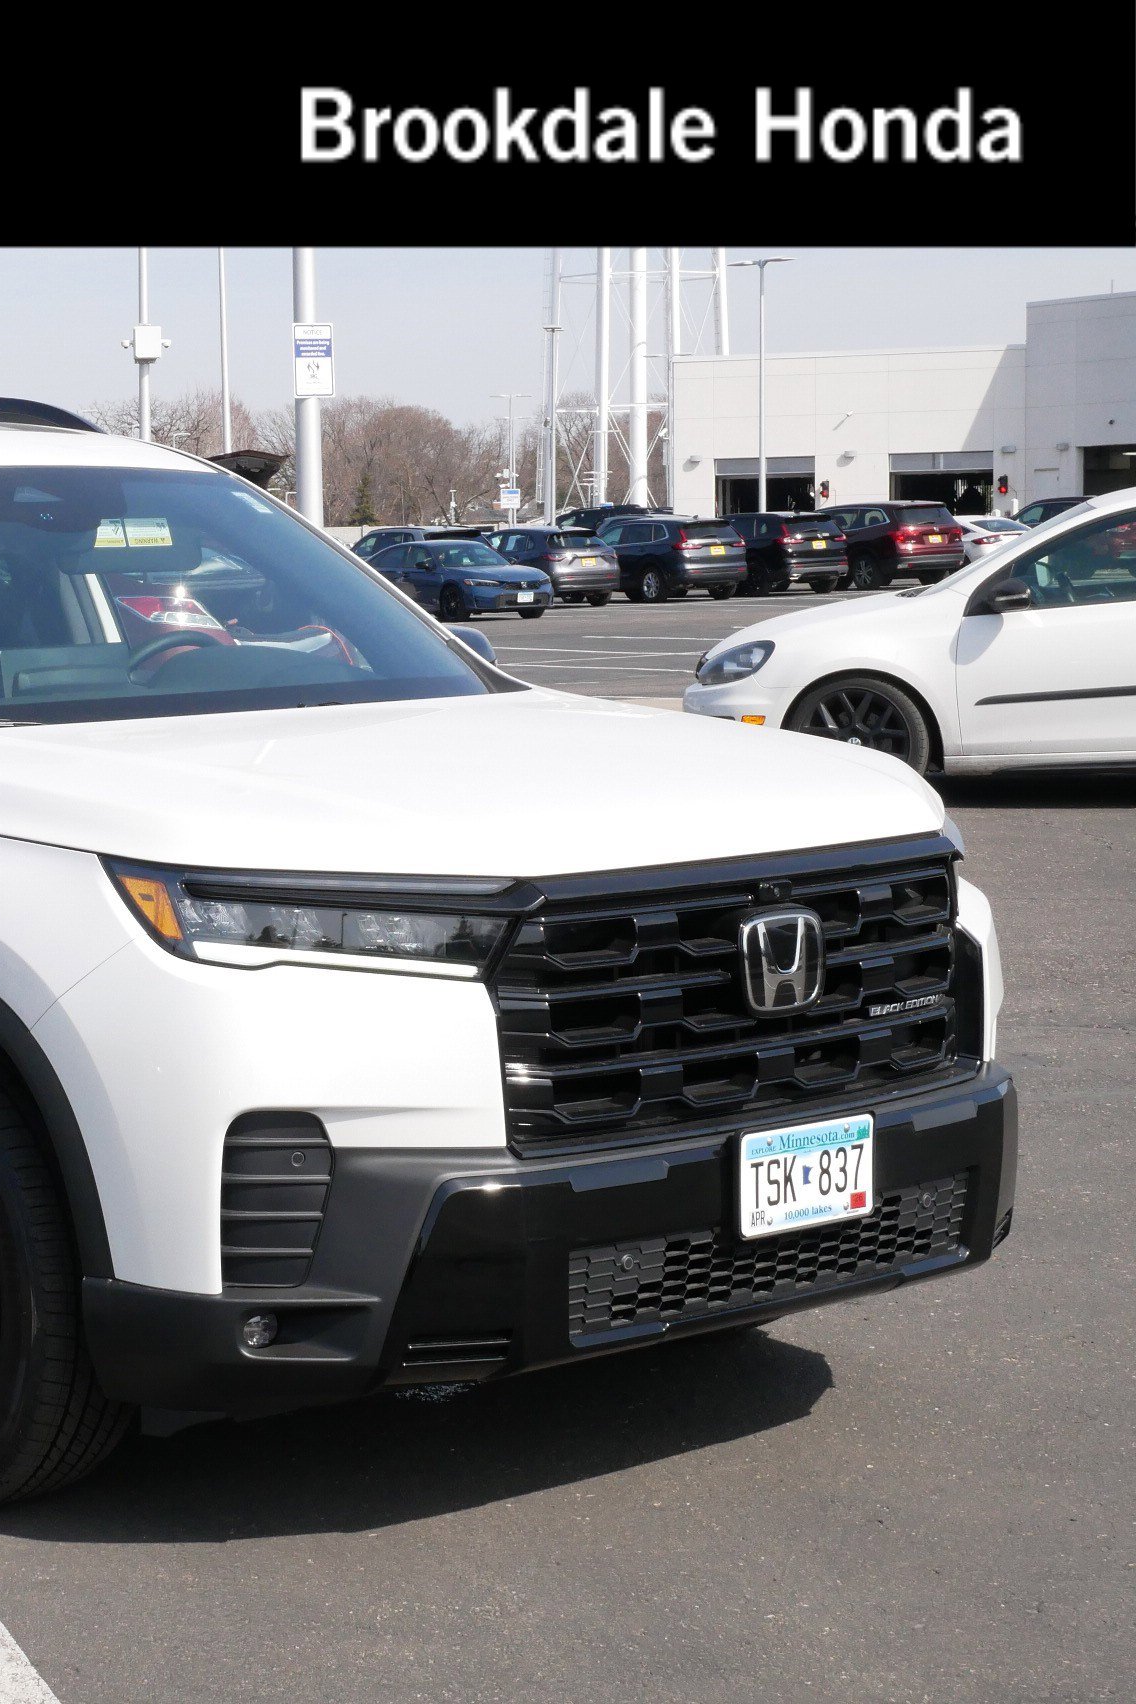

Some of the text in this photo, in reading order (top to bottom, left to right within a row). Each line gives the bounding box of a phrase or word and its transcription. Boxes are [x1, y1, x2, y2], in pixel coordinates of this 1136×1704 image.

[870, 994, 940, 1017] BLACK EDITION
[750, 1143, 864, 1210] TSK 837
[750, 1210, 765, 1228] APR
[784, 1204, 833, 1221] 10,000 lakes
